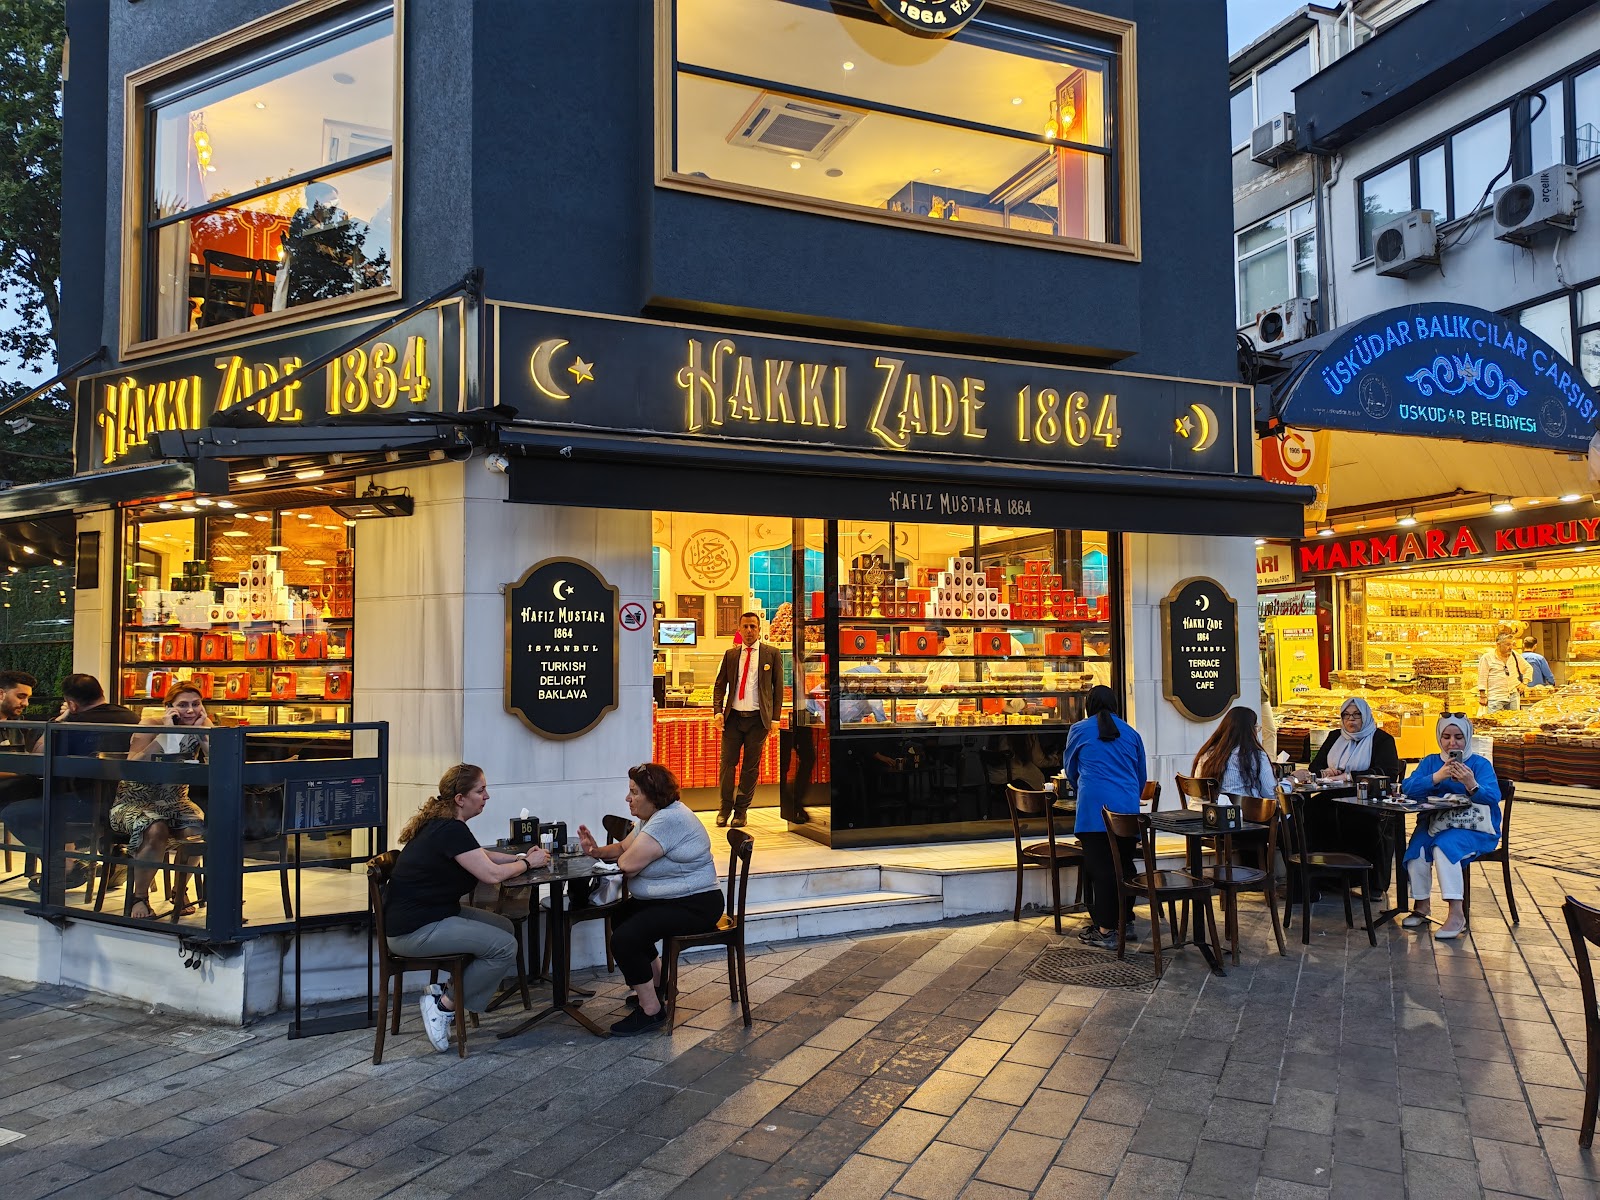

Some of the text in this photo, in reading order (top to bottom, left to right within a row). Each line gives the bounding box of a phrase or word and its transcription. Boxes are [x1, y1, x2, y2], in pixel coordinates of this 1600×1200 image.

[899, 1, 947, 24] 1864
[1540, 172, 1551, 203] arçelik
[1321, 321, 1413, 395] ÜSKÜDAR
[1415, 314, 1528, 360] BALIKÇILAR
[1532, 349, 1599, 424] ÇARŞISI
[677, 338, 1122, 449] HAKKI ZADE 1864
[97, 335, 431, 465] HAKKI ZADE 1864
[889, 490, 1032, 516] HAFIZ MUSTAFA 1864
[1299, 525, 1482, 573] MARMARA
[520, 606, 606, 624] HAFIZ MUSTAFA
[1182, 616, 1223, 632] HAKKI ZADE
[553, 627, 573, 639] 1864
[1196, 632, 1210, 642] 1864
[541, 661, 586, 672] TURKISH
[1188, 659, 1220, 668] TERRACE
[1190, 670, 1219, 679] SALOON
[539, 676, 586, 686] DELIGHT
[1195, 681, 1215, 690] CAFE
[538, 689, 588, 700] BAKLAVA
[1226, 808, 1236, 820] B9
[521, 822, 533, 834] B6
